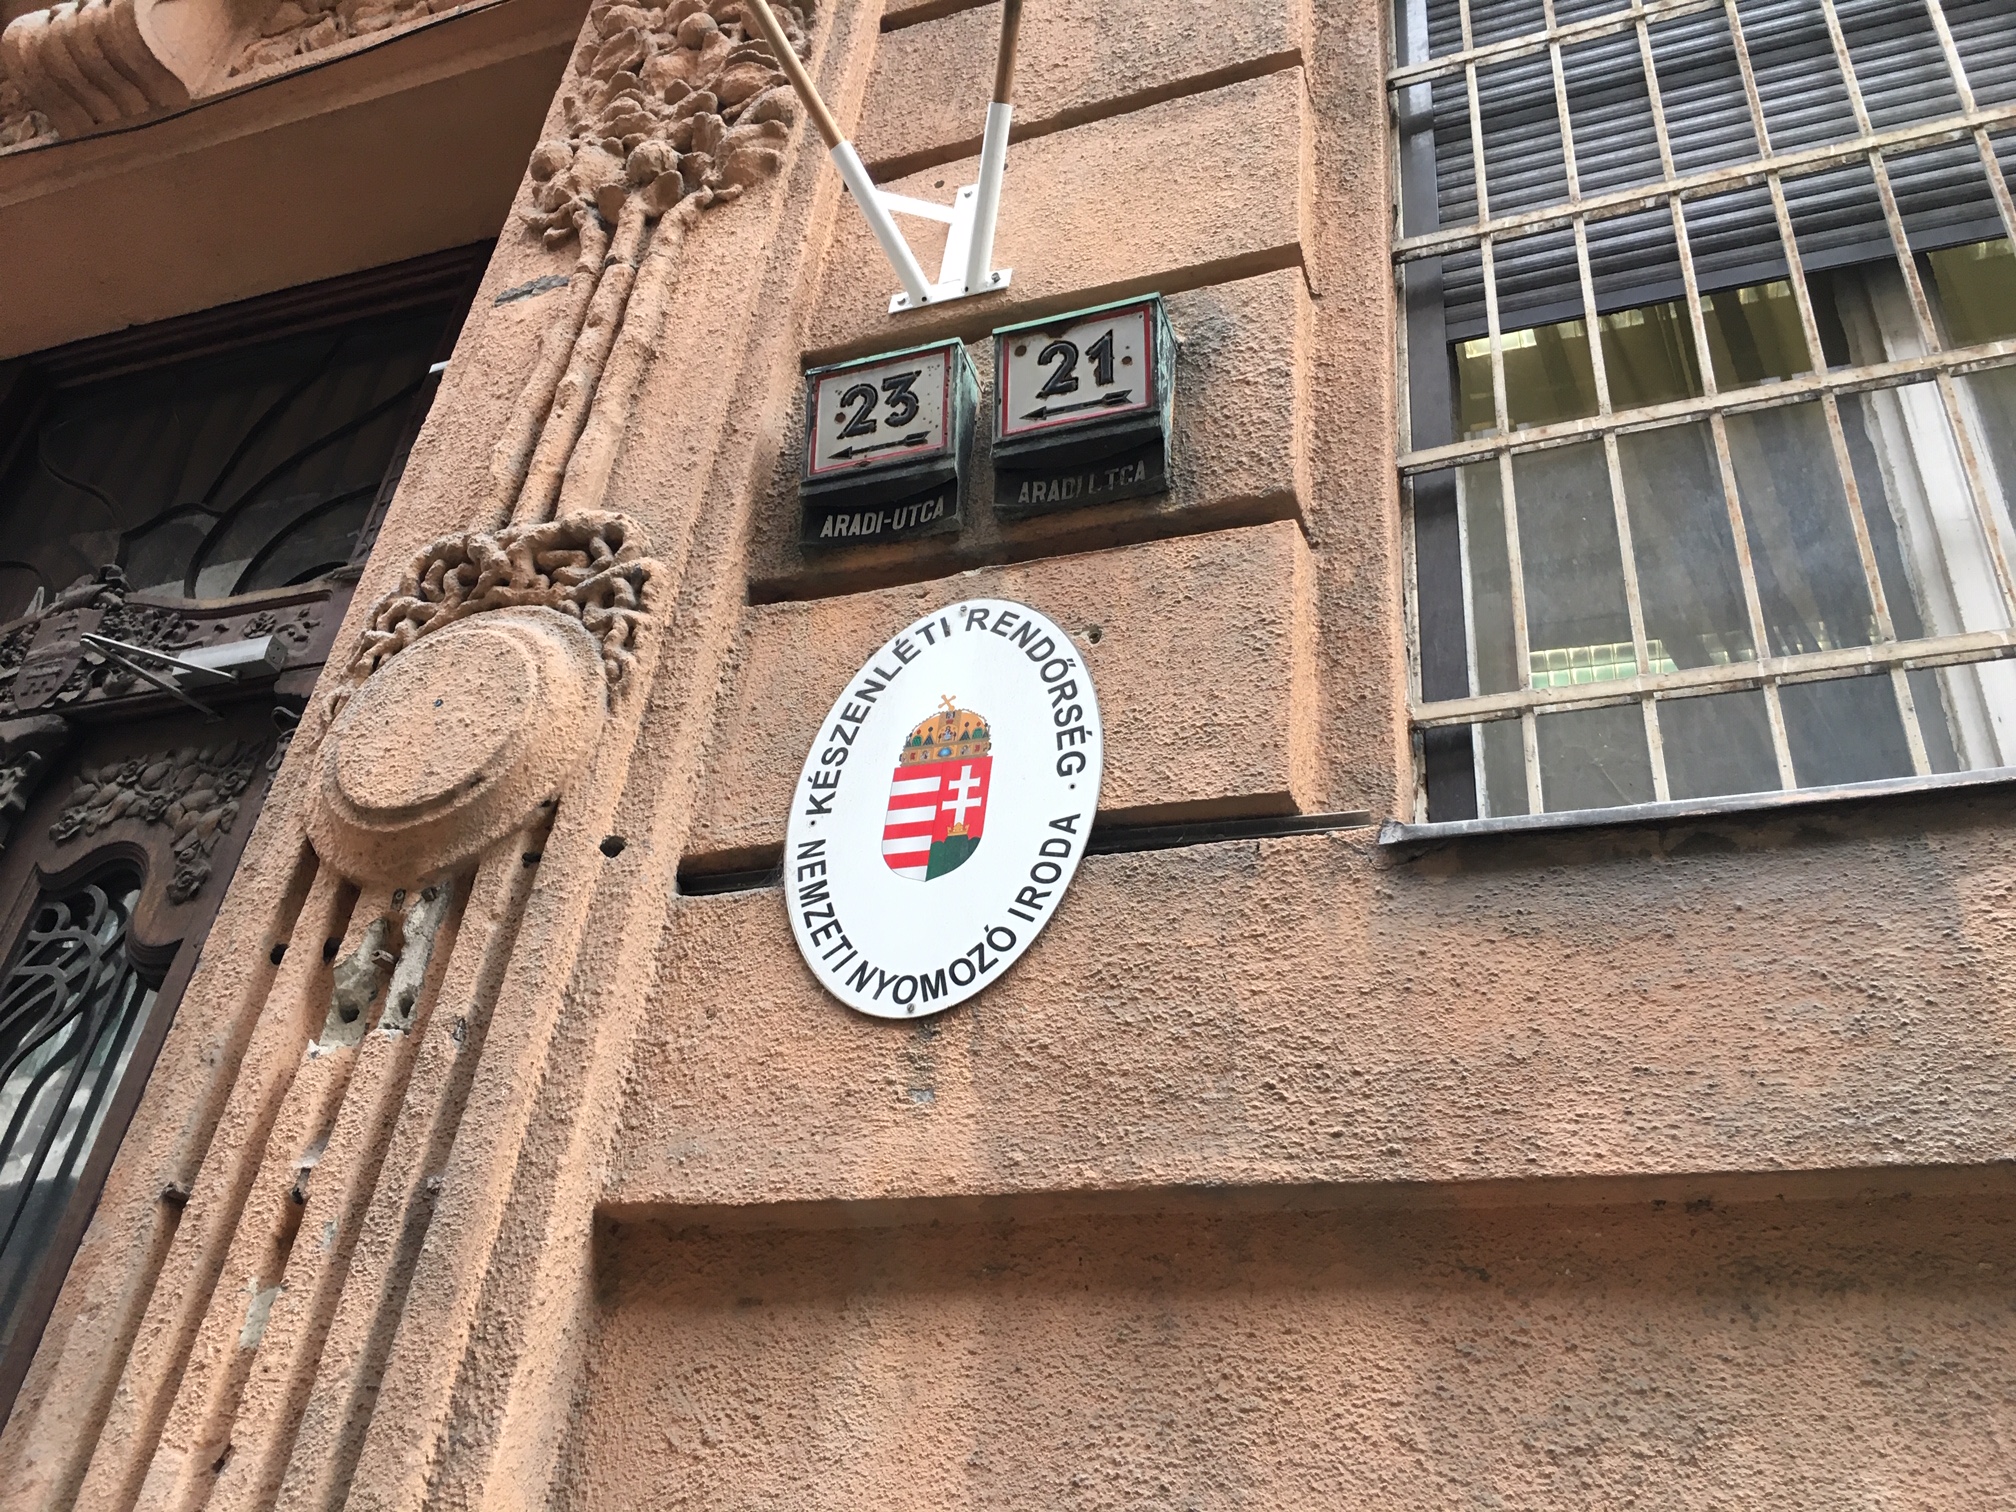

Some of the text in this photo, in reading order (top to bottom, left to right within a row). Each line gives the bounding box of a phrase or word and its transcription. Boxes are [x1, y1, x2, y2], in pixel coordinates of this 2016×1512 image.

[1035, 329, 1116, 399] 21
[836, 370, 922, 440] 23
[819, 495, 945, 538] ARADI-UTCA
[1018, 475, 1083, 504] ARADI
[805, 607, 1093, 815] KÉSZENLÉTI RENDŐRSÉG
[796, 812, 1082, 1005] NEMZETI NYOMOZÓ IRODA
